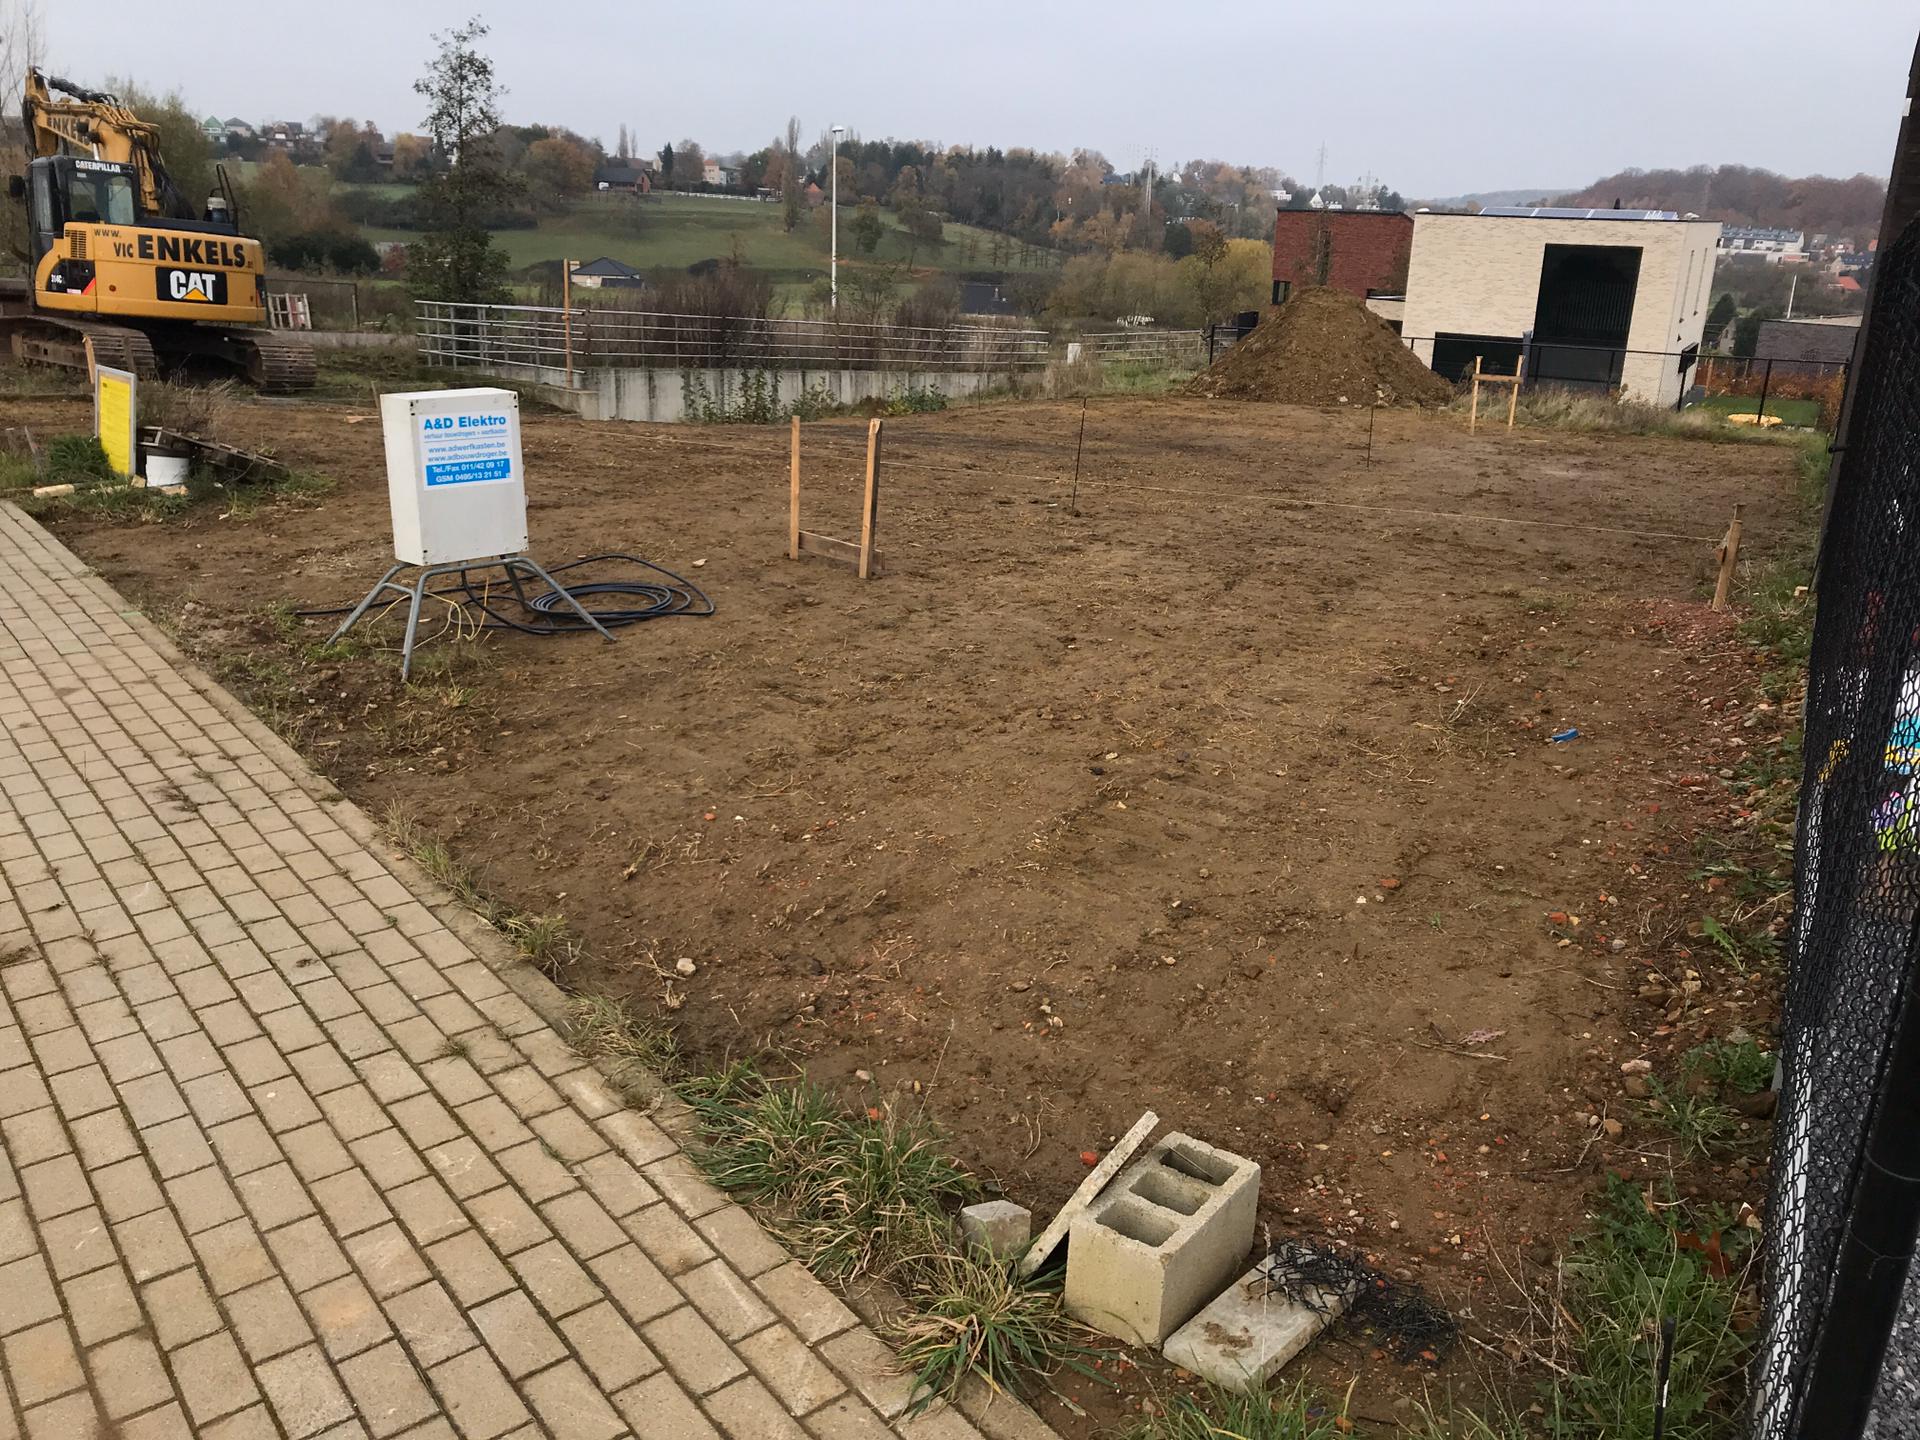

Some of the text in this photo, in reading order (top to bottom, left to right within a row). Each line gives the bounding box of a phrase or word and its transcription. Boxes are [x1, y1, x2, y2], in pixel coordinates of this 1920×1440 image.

[75, 160, 121, 173] CATERPILLAR
[113, 233, 246, 268] VIC ENKELS
[169, 270, 216, 302] CAT
[424, 415, 506, 430] A&D Elektro
[428, 442, 506, 453] www.adwerfkasten.be
[435, 475, 454, 483] GSM
